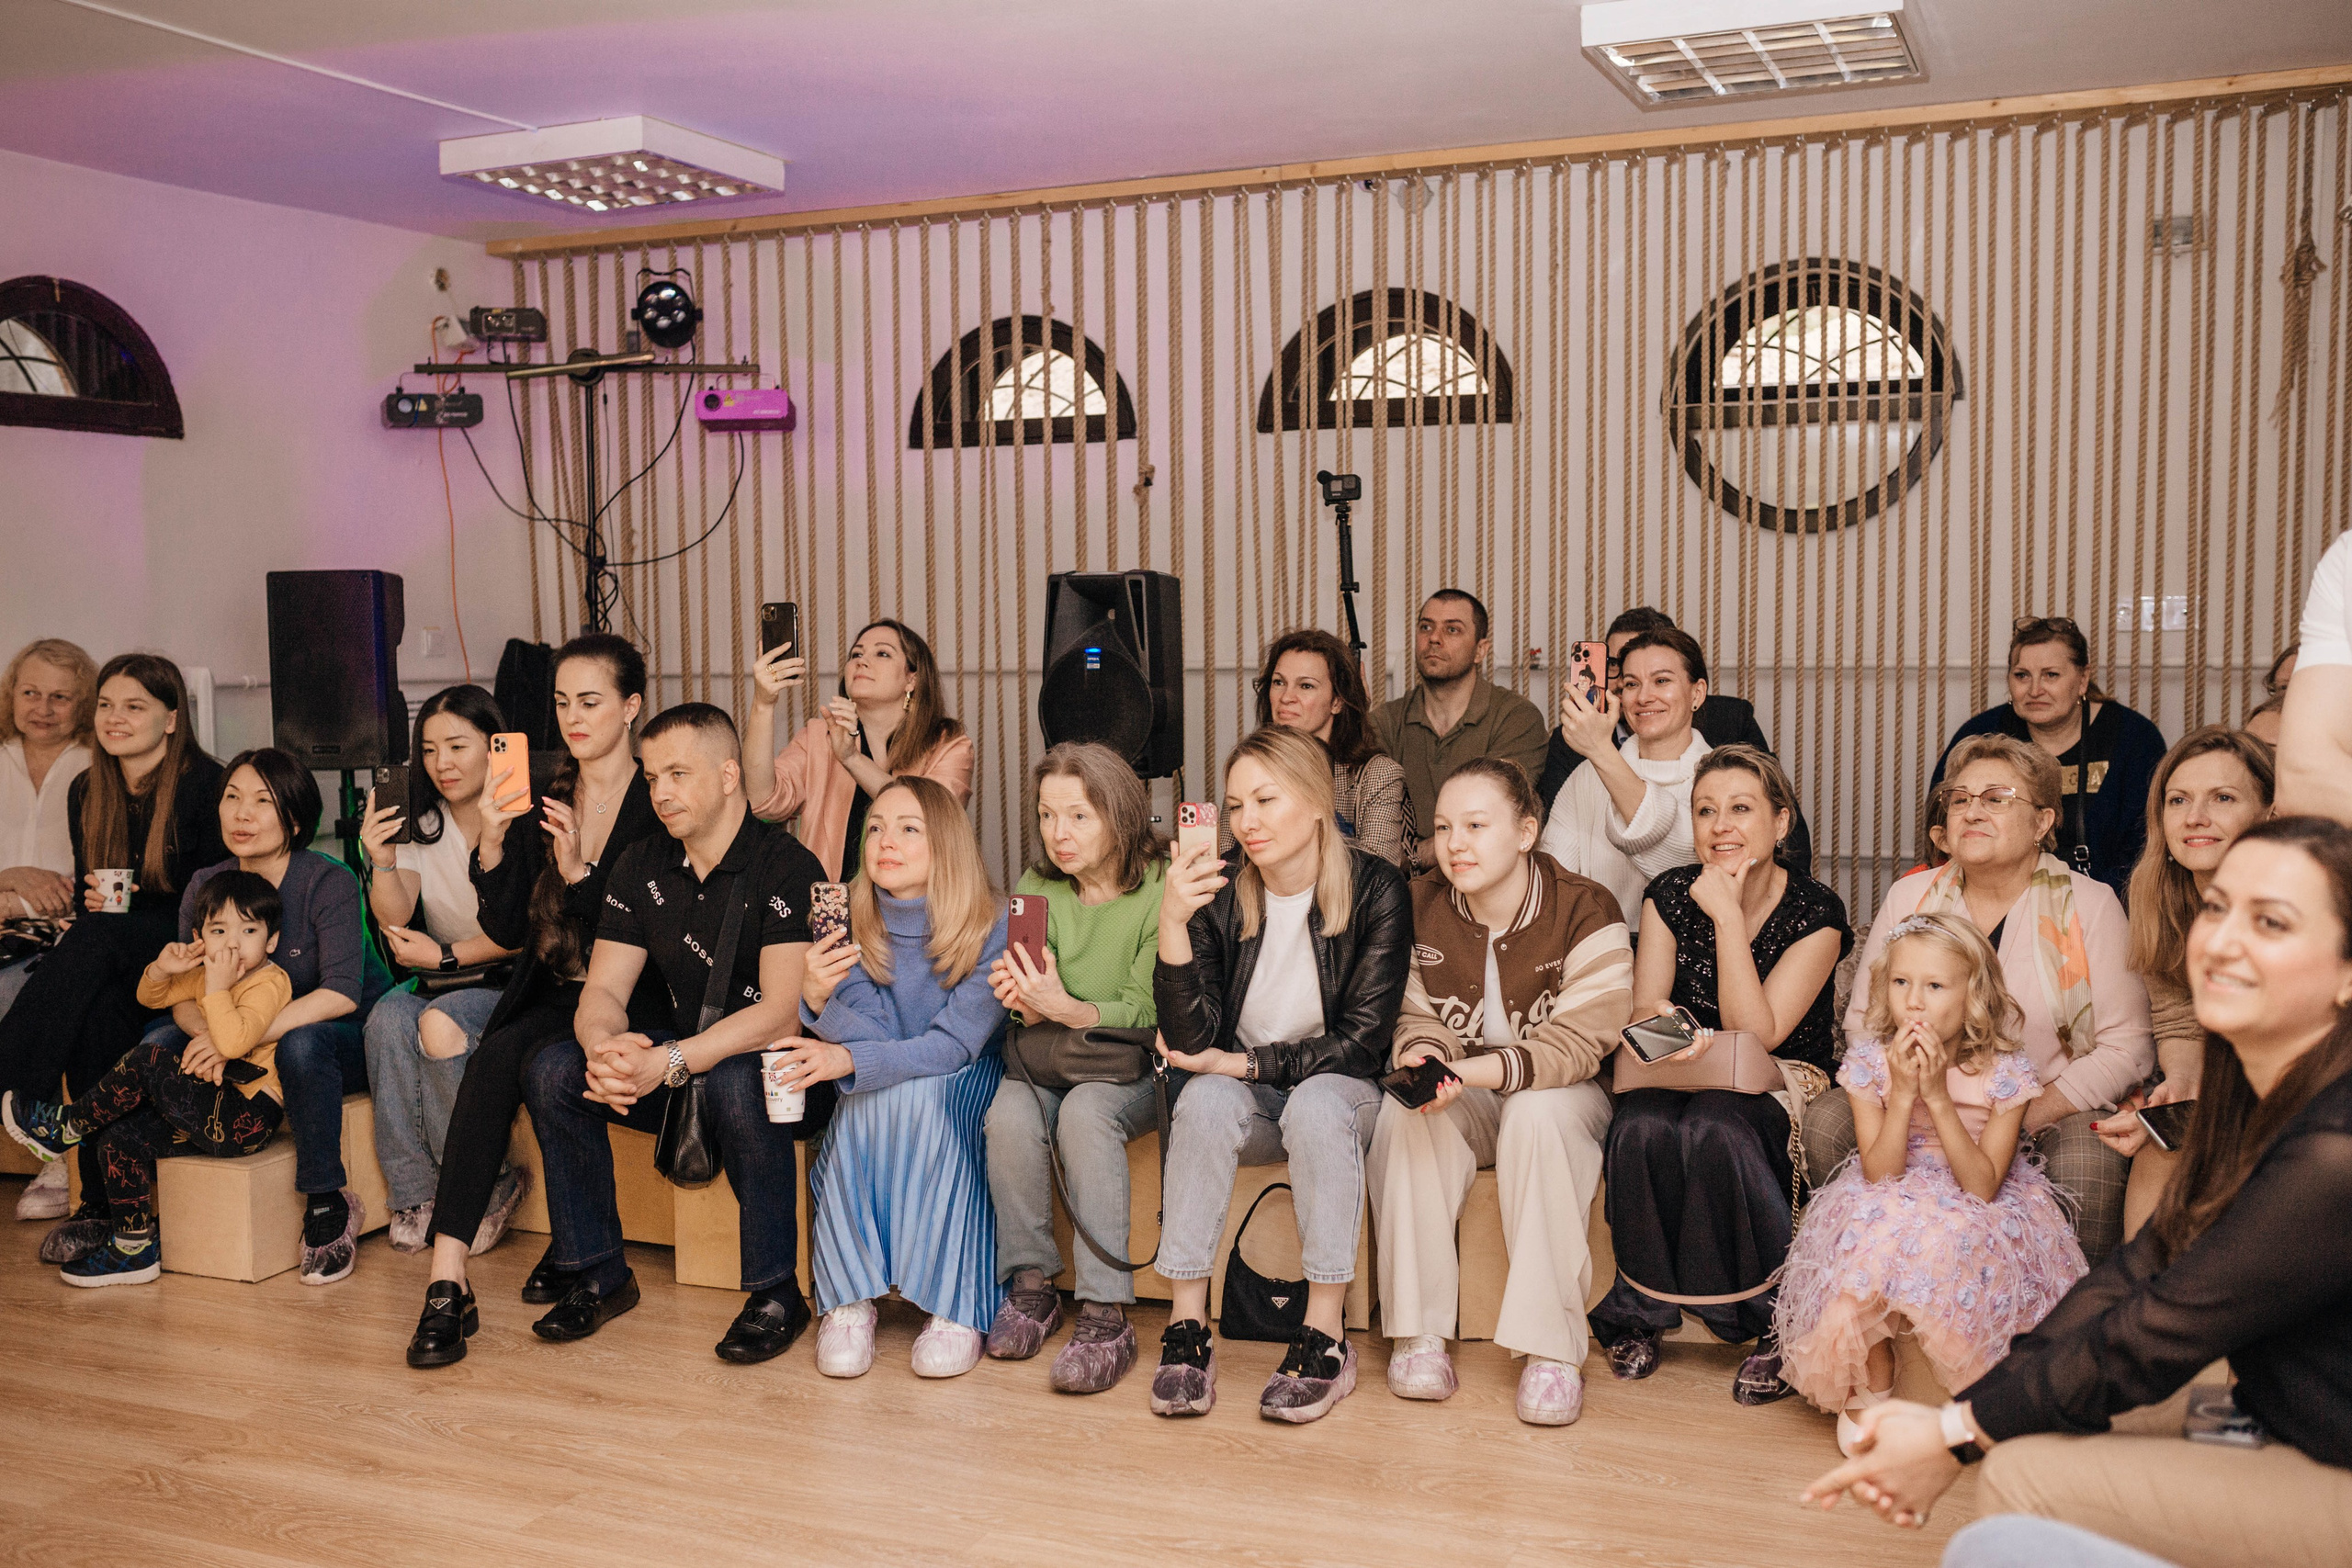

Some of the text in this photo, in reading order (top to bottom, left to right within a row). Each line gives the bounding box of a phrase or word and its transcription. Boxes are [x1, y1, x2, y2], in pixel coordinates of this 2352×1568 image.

[647, 880, 664, 906] BOSS
[684, 933, 713, 966] BOSS
[1422, 952, 1438, 960] CALL
[743, 986, 763, 1002] BO
